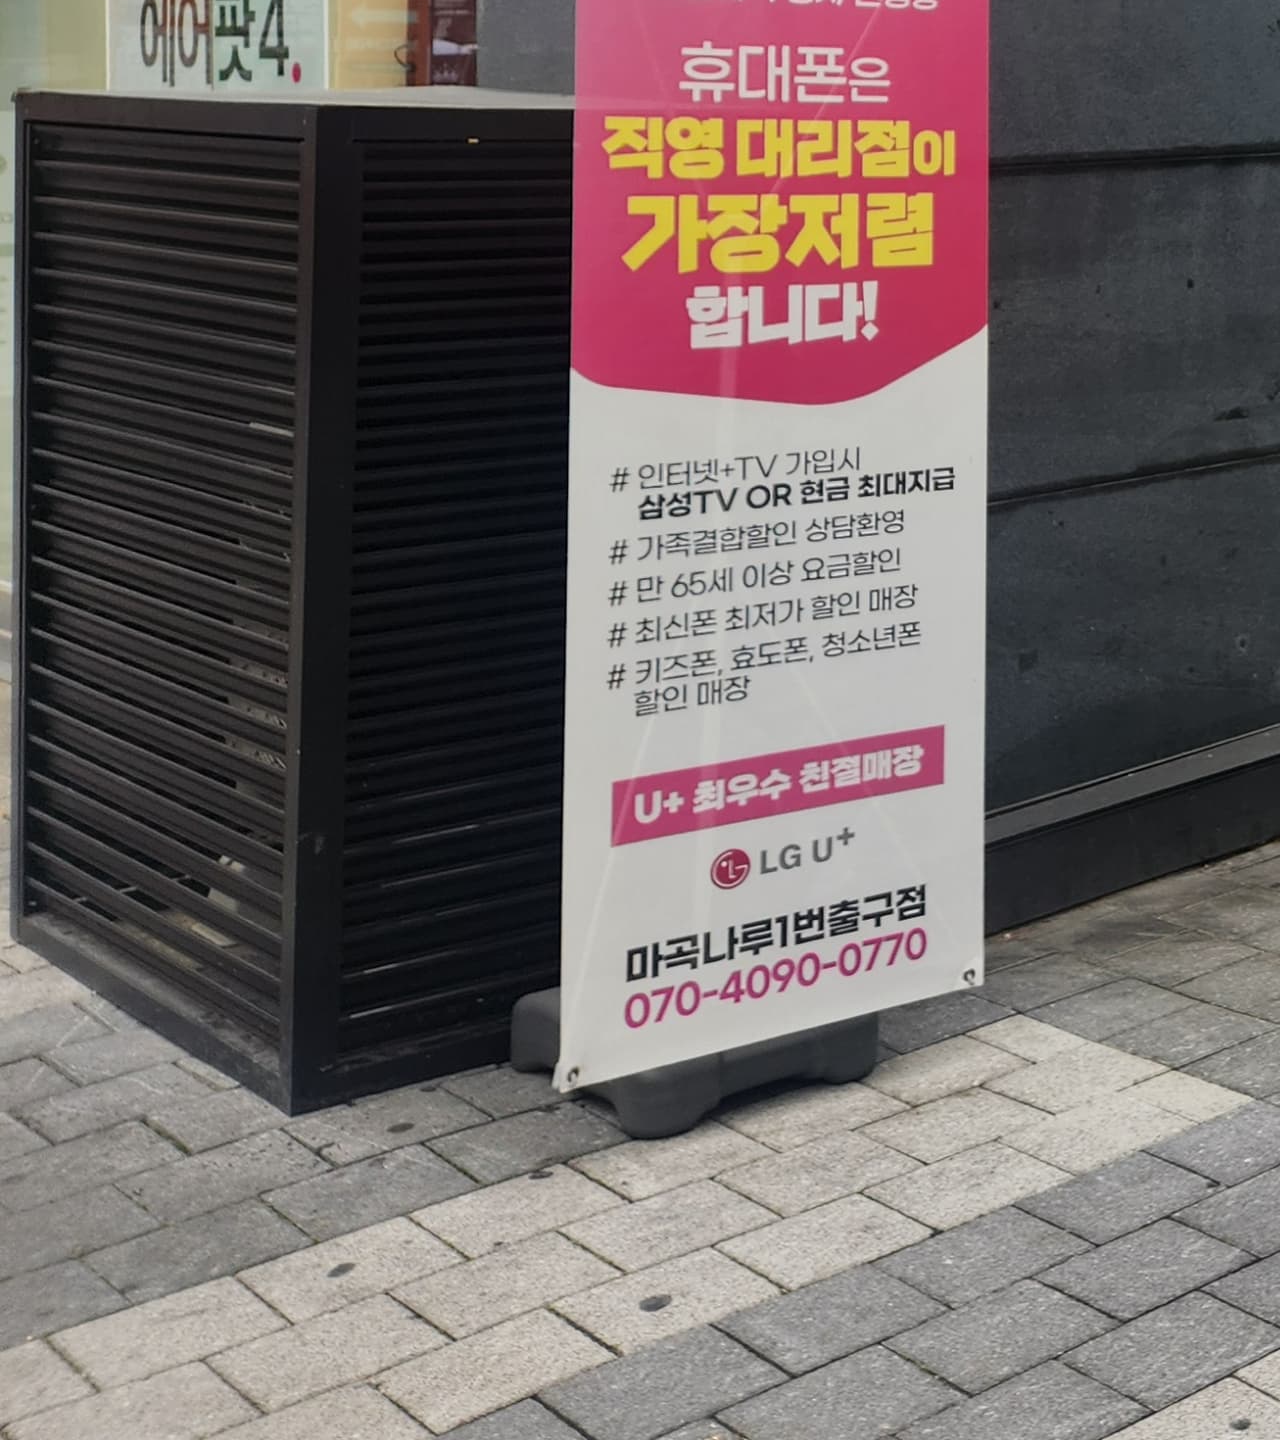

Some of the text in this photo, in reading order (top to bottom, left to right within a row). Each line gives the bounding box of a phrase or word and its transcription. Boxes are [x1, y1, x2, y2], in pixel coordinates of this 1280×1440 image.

[679, 41, 892, 104] 휴대폰은
[601, 115, 957, 179] 직영 대리점이
[621, 193, 935, 274] 가장저렴
[686, 281, 879, 350] 합니다!
[637, 453, 779, 491] 인터넷+TV
[785, 446, 861, 477] 가입시
[638, 466, 957, 521] 삼성TV OR 현금 최대지급
[636, 520, 797, 562] 가족결합할인
[804, 508, 906, 544] 상담환영
[636, 574, 664, 604] 만
[670, 565, 733, 600] 65세
[741, 559, 796, 590] 이상
[800, 546, 902, 584] 요금할인
[634, 608, 718, 646] 최신폰
[724, 597, 806, 633] 최저가
[811, 589, 862, 622] 할인
[868, 583, 920, 613] 매장
[634, 648, 724, 686] 키즈폰,
[730, 636, 815, 673] 효도폰,
[821, 621, 923, 660] 청소년폰
[633, 674, 752, 719] 할인 매장
[634, 743, 925, 825] U+ 최우수 친절매장
[626, 883, 928, 984] 마곡나루1번출구점
[623, 926, 928, 1030] 070-4090-0770
